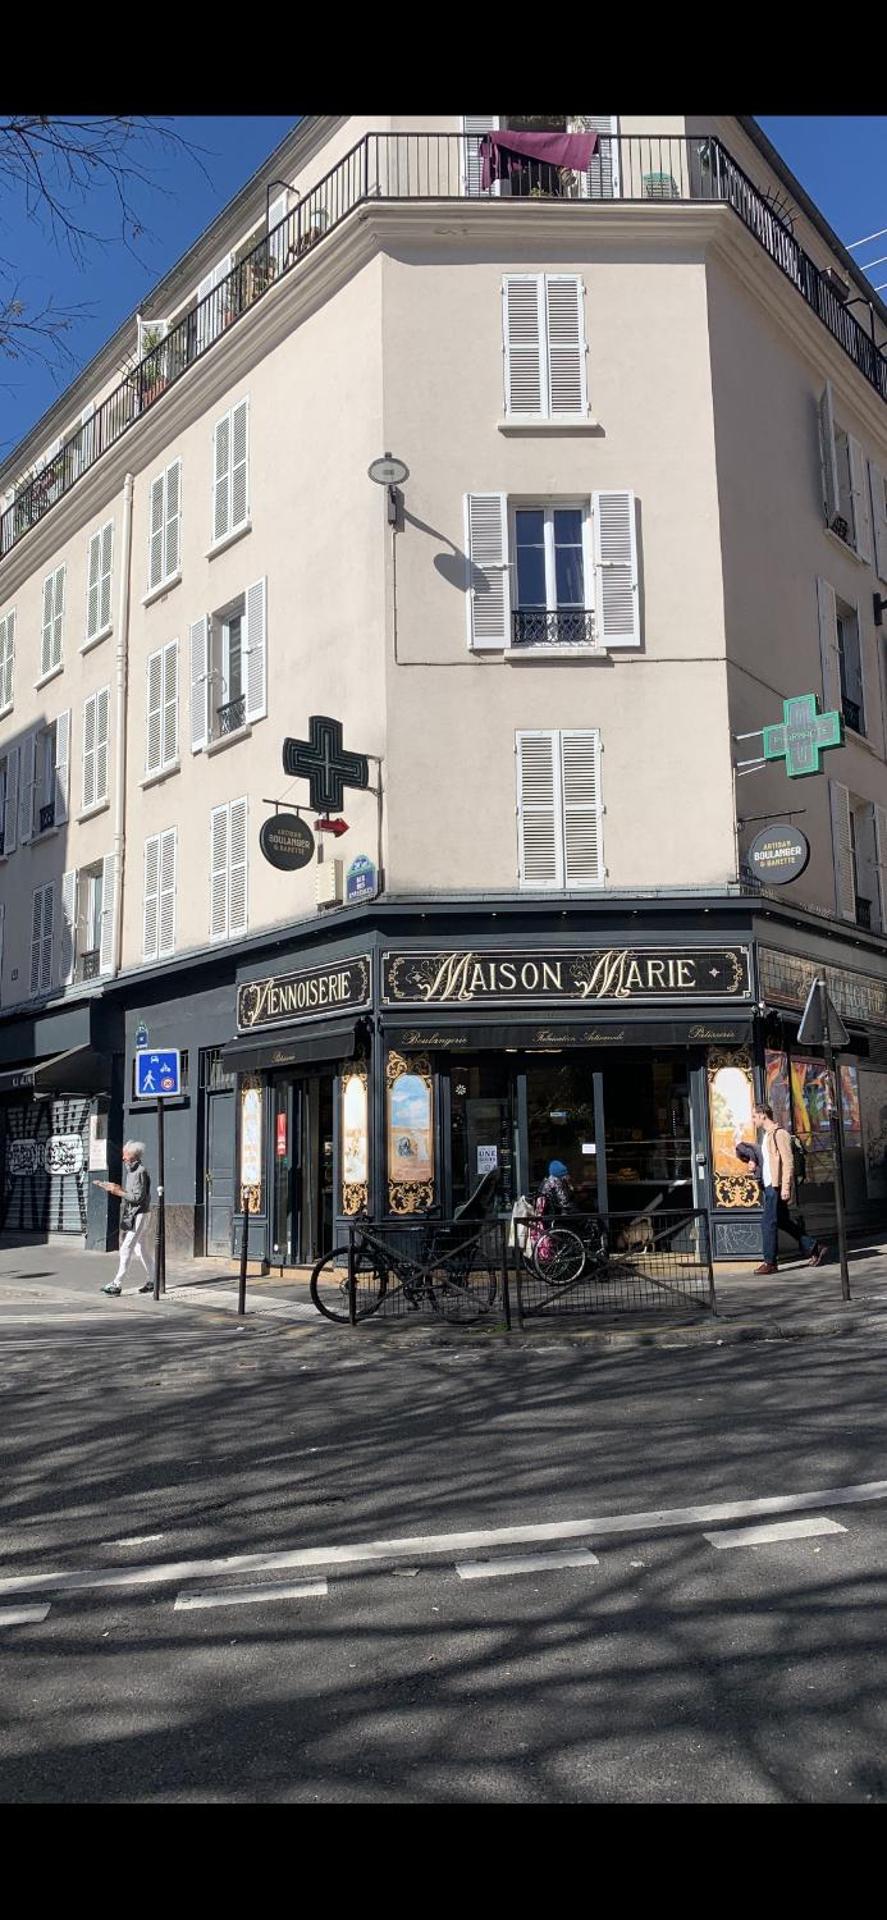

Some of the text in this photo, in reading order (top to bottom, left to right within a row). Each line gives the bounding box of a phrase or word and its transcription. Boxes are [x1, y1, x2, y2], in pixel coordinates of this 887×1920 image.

[268, 834, 311, 849] BOULANGER
[763, 840, 792, 850] ARTISAN
[754, 846, 802, 861] BOULANGER
[417, 950, 696, 1001] MAISON MARIE
[243, 972, 351, 1025] VIENNOISERIE
[402, 1030, 467, 1047] Boulangerie
